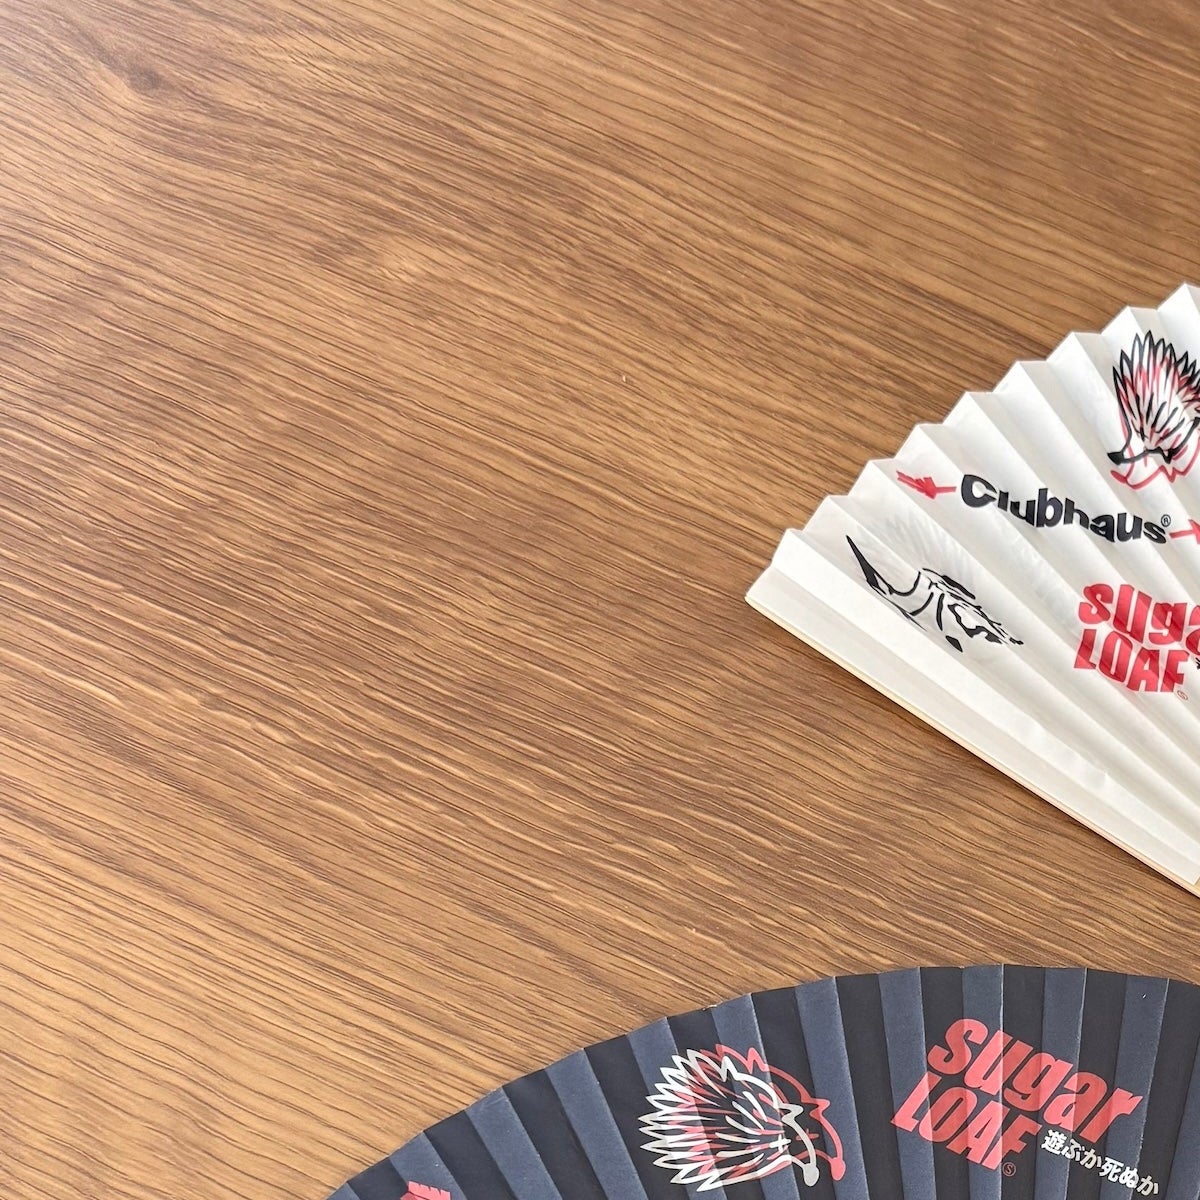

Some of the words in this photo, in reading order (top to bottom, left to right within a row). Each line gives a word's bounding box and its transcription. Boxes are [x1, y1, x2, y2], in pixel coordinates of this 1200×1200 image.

[927, 1018, 1143, 1143] sugar
[1040, 1130, 1159, 1196] 遊ぶか死ぬか
